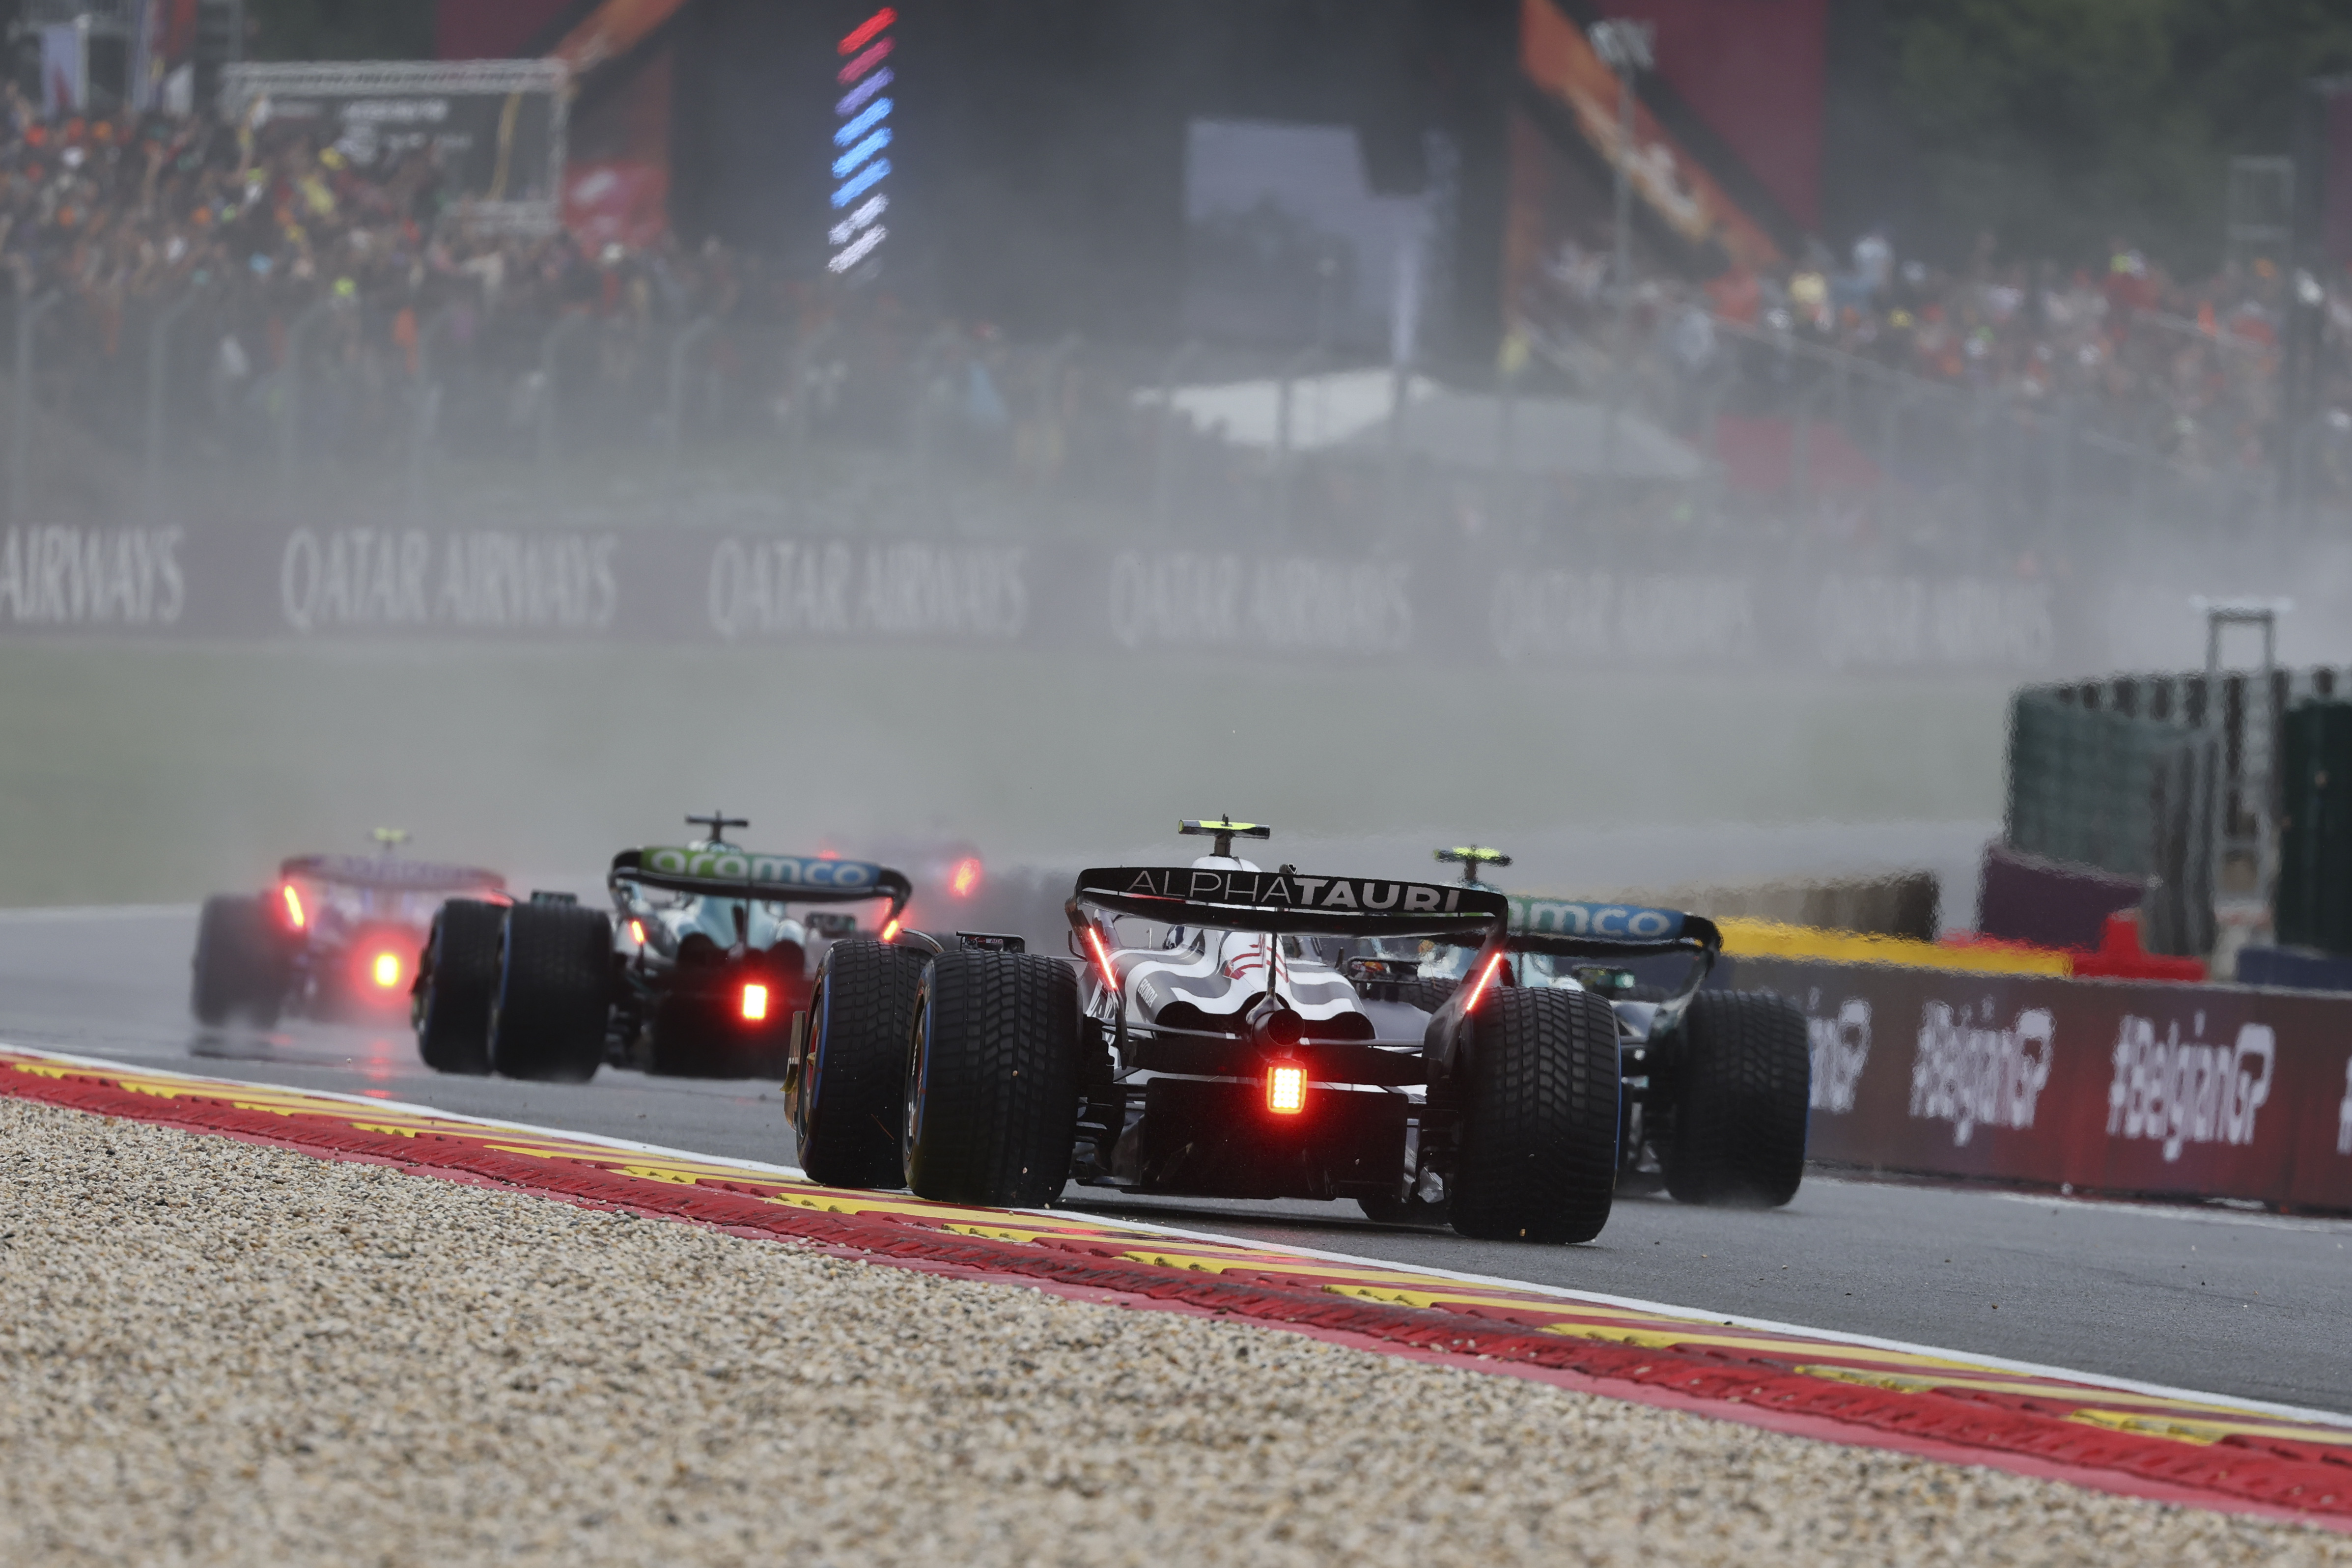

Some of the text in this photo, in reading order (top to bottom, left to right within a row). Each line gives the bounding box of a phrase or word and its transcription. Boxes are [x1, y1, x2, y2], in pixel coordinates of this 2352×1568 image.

[281, 527, 621, 633] QATAR AIRWAYS
[710, 536, 852, 644] QATAR
[651, 850, 872, 886] aramco
[1126, 869, 1461, 912] ALPHATAURI
[1509, 900, 1671, 936] mco
[1137, 978, 1158, 1008] HONDA
